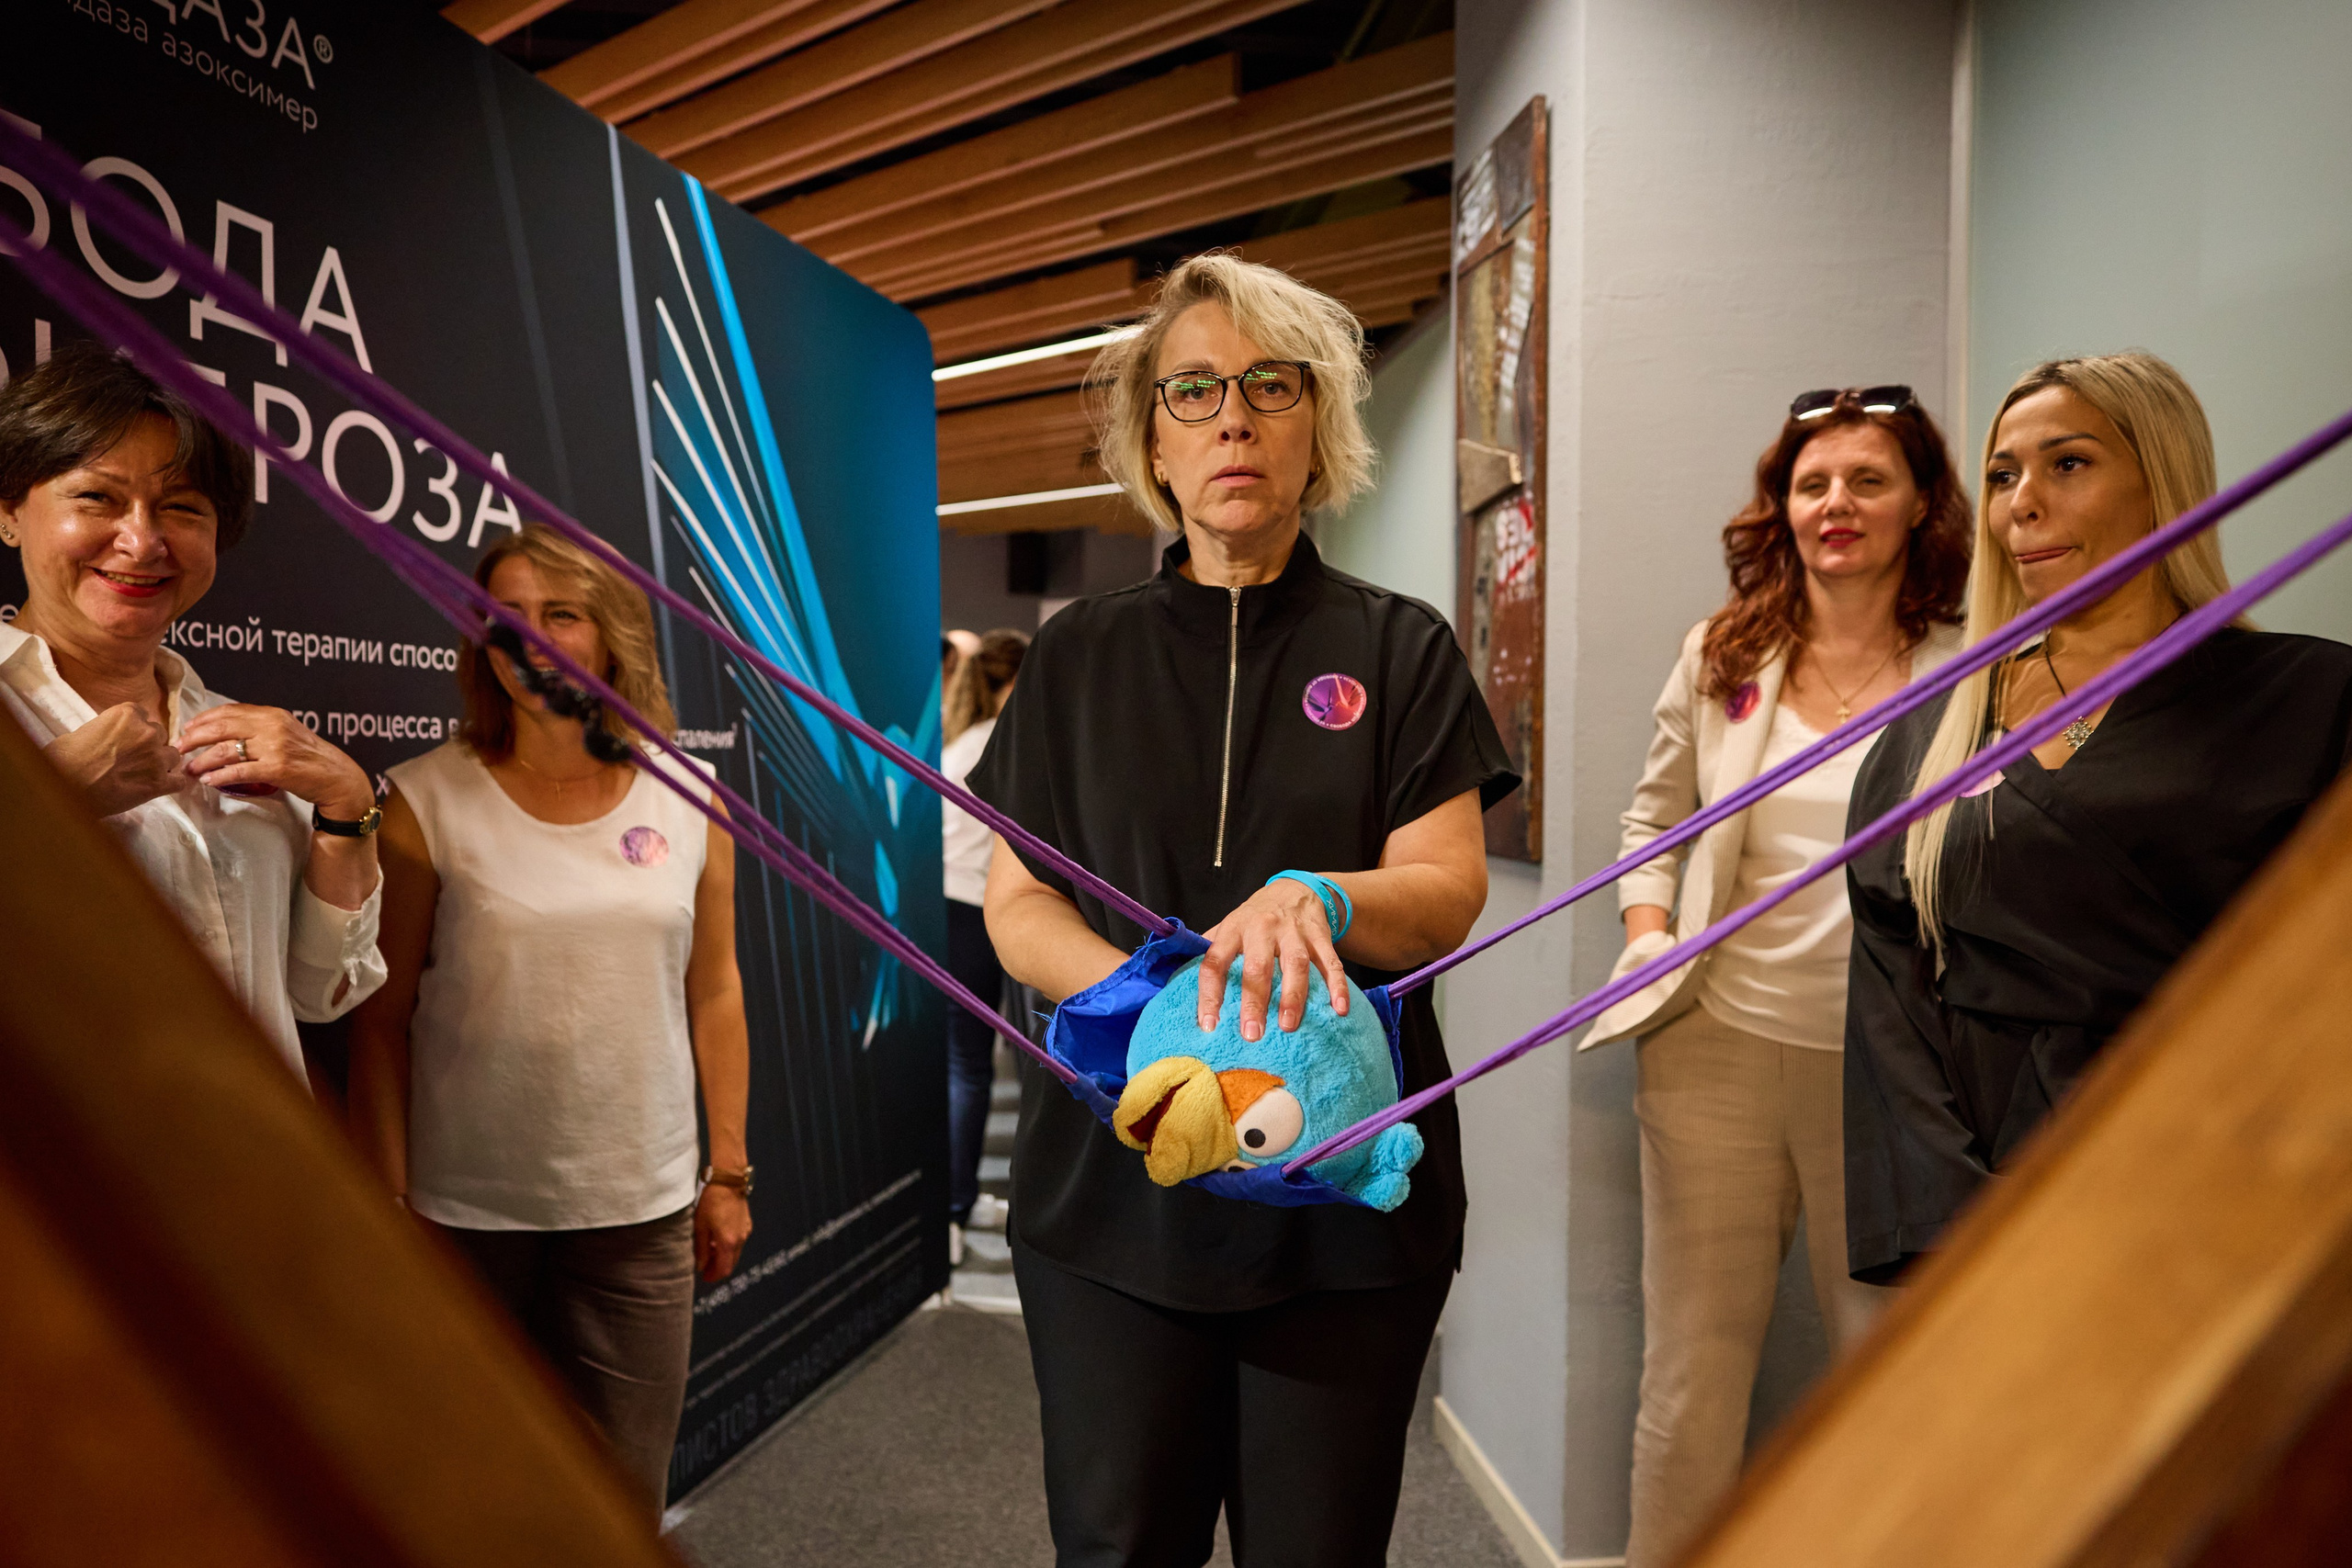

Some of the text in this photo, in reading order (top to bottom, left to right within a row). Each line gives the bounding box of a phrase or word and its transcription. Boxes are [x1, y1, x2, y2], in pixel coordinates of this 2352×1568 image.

[162, 32, 318, 133] азоксимер
[272, 628, 384, 666] терапии
[327, 711, 443, 745] процесса
